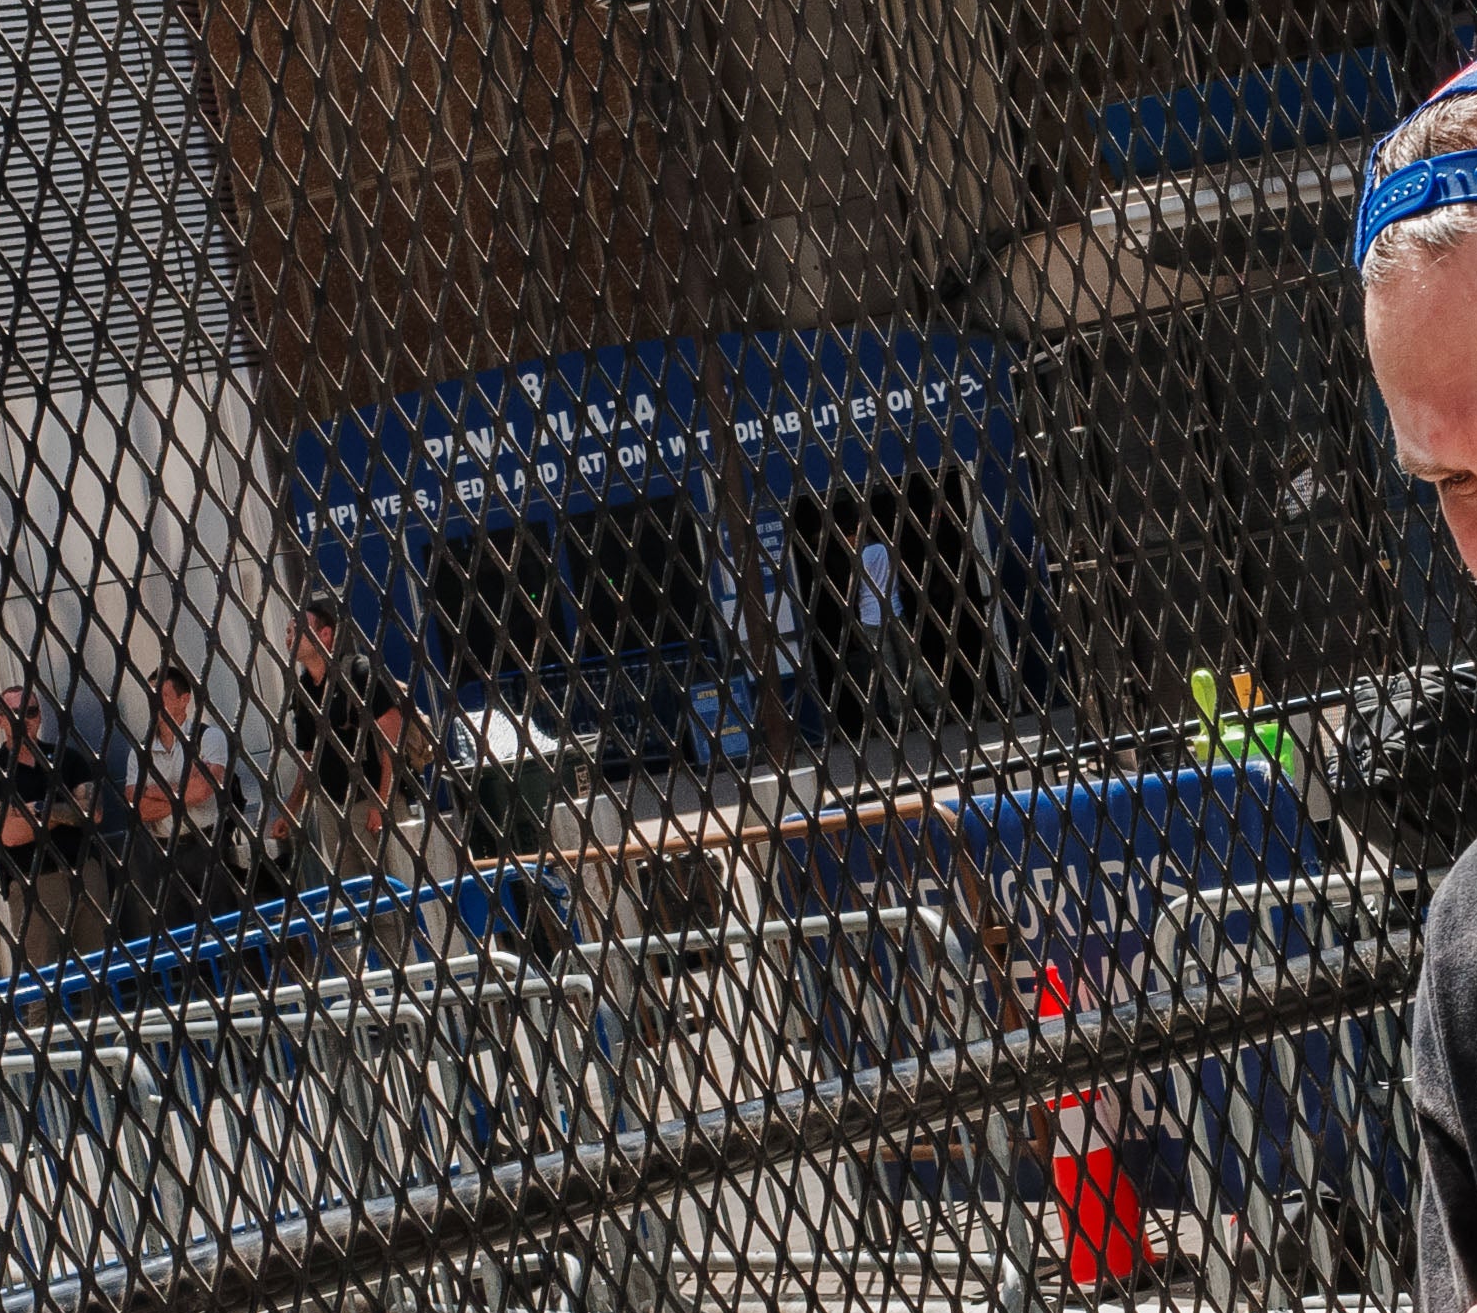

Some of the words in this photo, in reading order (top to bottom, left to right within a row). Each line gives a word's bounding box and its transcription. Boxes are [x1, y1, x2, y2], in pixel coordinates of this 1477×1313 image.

[522, 373, 542, 403] 8
[887, 382, 947, 413] ONLY
[424, 421, 516, 470] PENN
[540, 393, 656, 446] PLAZA
